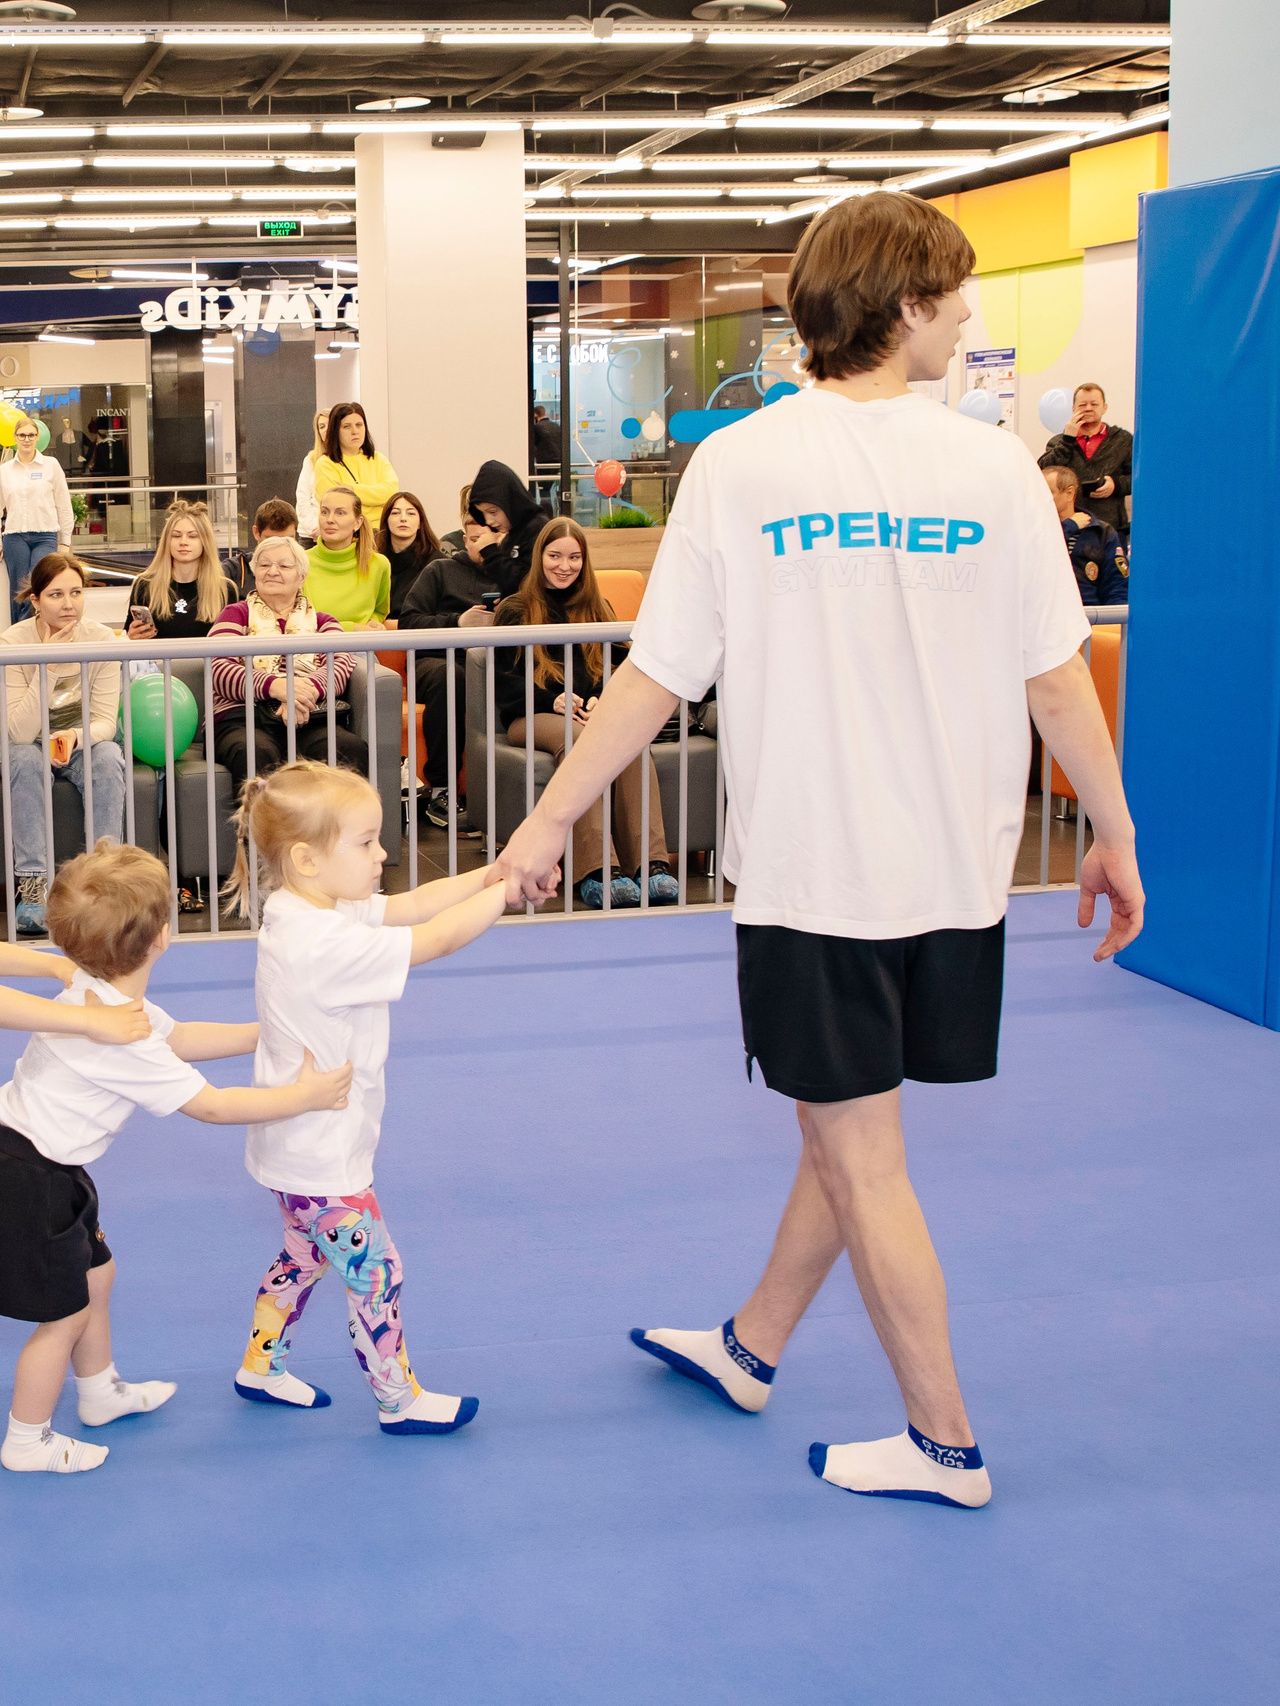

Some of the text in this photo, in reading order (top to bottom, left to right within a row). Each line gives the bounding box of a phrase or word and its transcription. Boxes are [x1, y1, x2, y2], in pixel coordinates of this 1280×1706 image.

[264, 221, 297, 230] ВЫХОД
[761, 511, 985, 556] ТРЕНЕР
[768, 554, 979, 596] GYMTEAM
[922, 1439, 967, 1460] GYM
